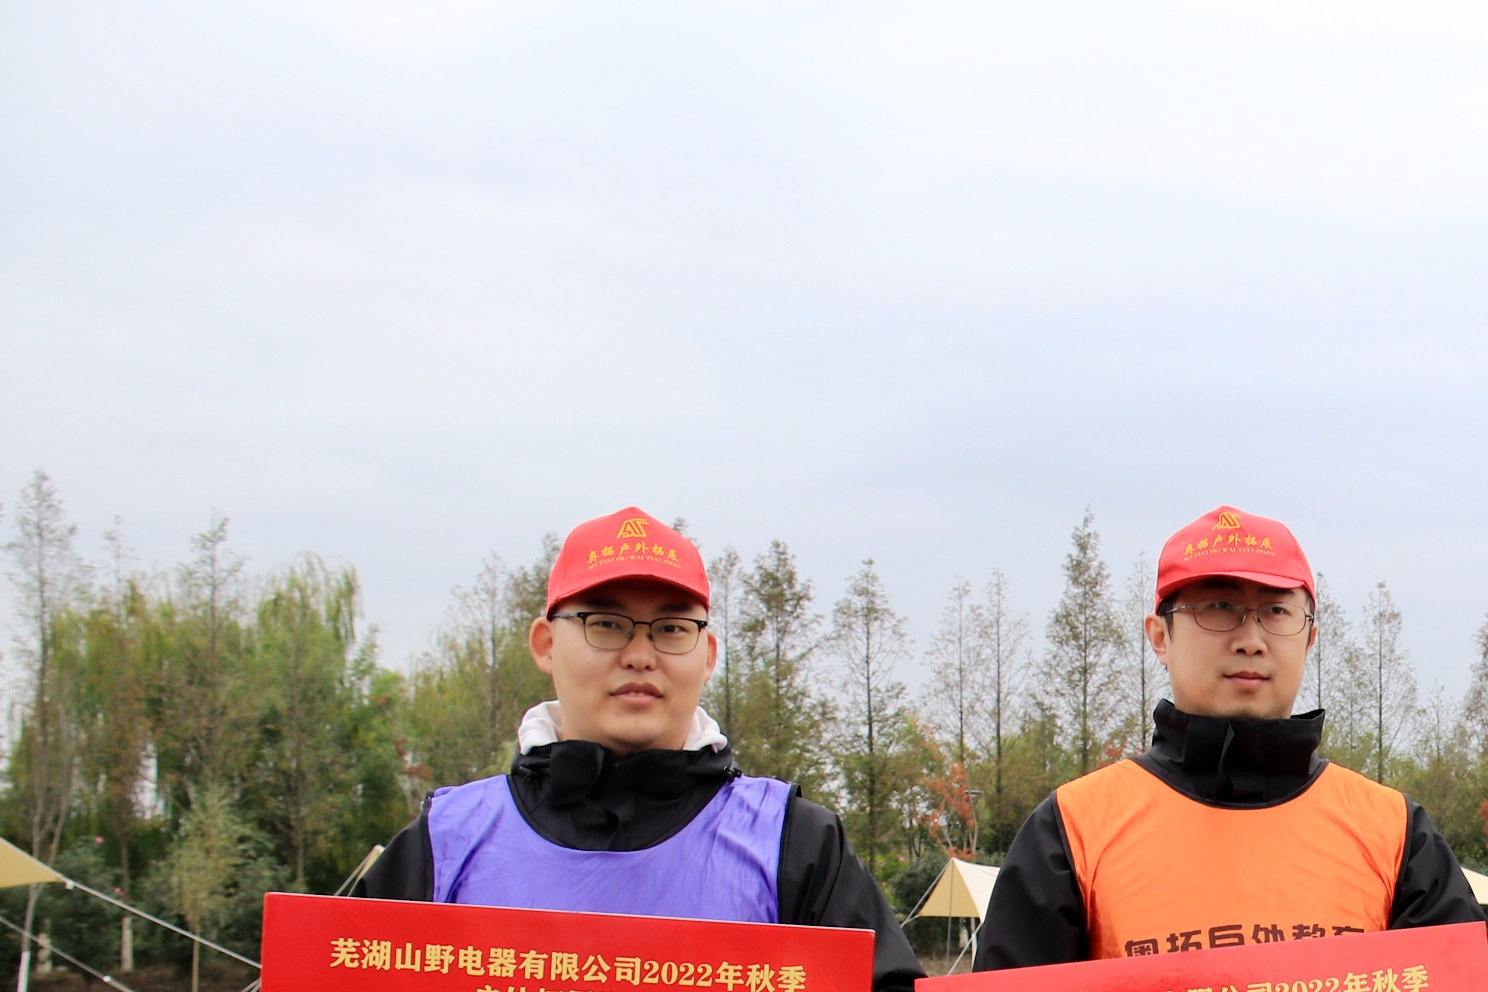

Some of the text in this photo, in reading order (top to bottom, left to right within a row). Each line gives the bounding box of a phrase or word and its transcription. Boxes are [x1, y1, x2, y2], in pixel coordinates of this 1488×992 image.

[587, 541, 679, 564] 奥拓户外拓展
[1183, 533, 1273, 557] 奥拓户外拓展
[1124, 923, 1365, 958] 奥拓户外
